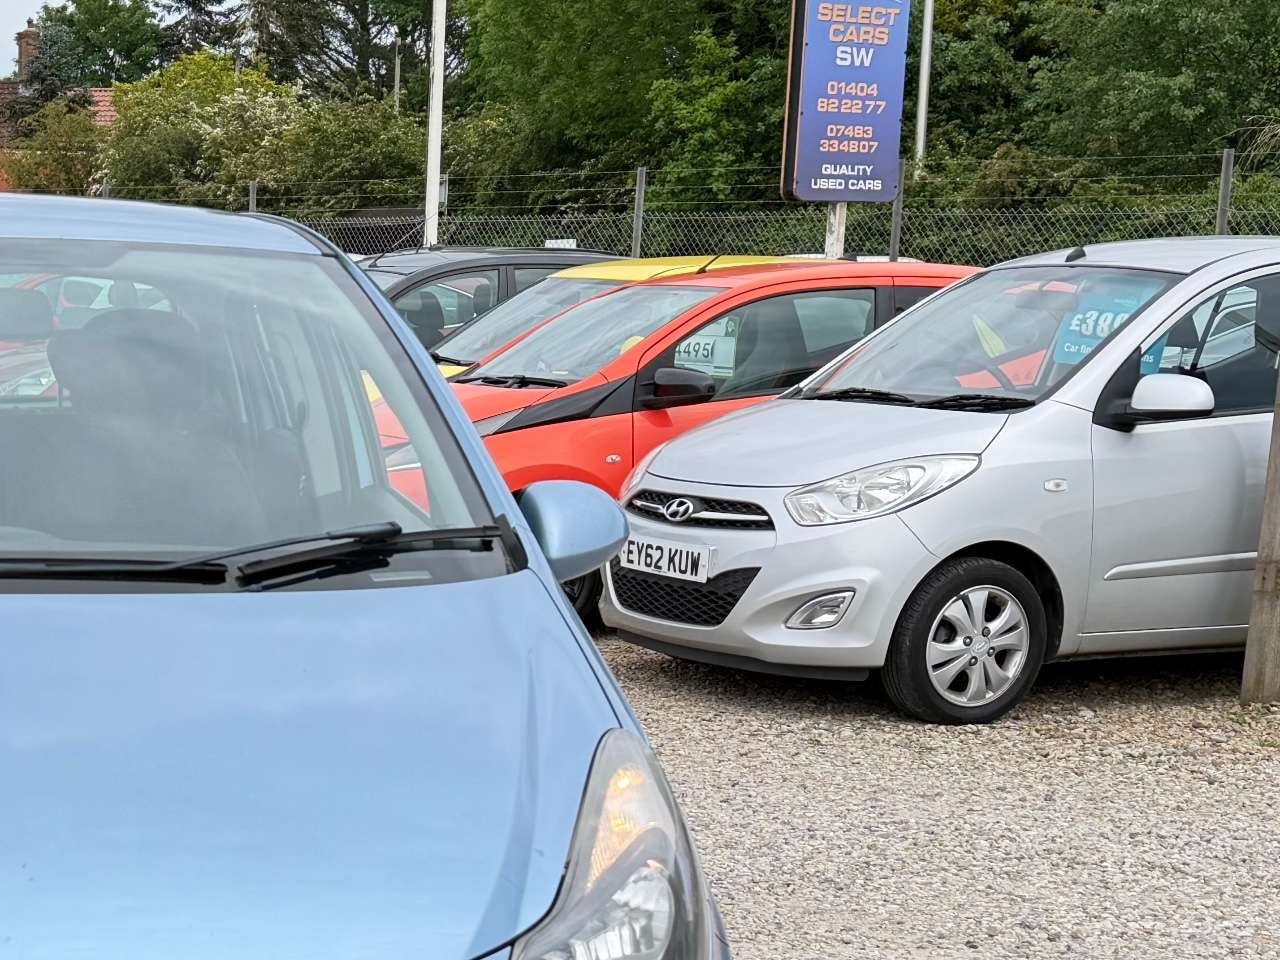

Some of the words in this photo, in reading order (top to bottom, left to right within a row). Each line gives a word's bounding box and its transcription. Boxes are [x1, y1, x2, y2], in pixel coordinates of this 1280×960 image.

[817, 2, 900, 26] SELECT
[829, 24, 889, 46] CARS
[835, 45, 874, 67] SW
[827, 81, 879, 97] 01404
[826, 124, 874, 138] 07483
[819, 139, 880, 154] 334807
[821, 164, 874, 176] QUALITY
[811, 178, 845, 190] USED
[848, 179, 882, 190] CARS
[1064, 342, 1079, 353] Car
[626, 540, 664, 570] EY62
[667, 547, 701, 577] KUW
